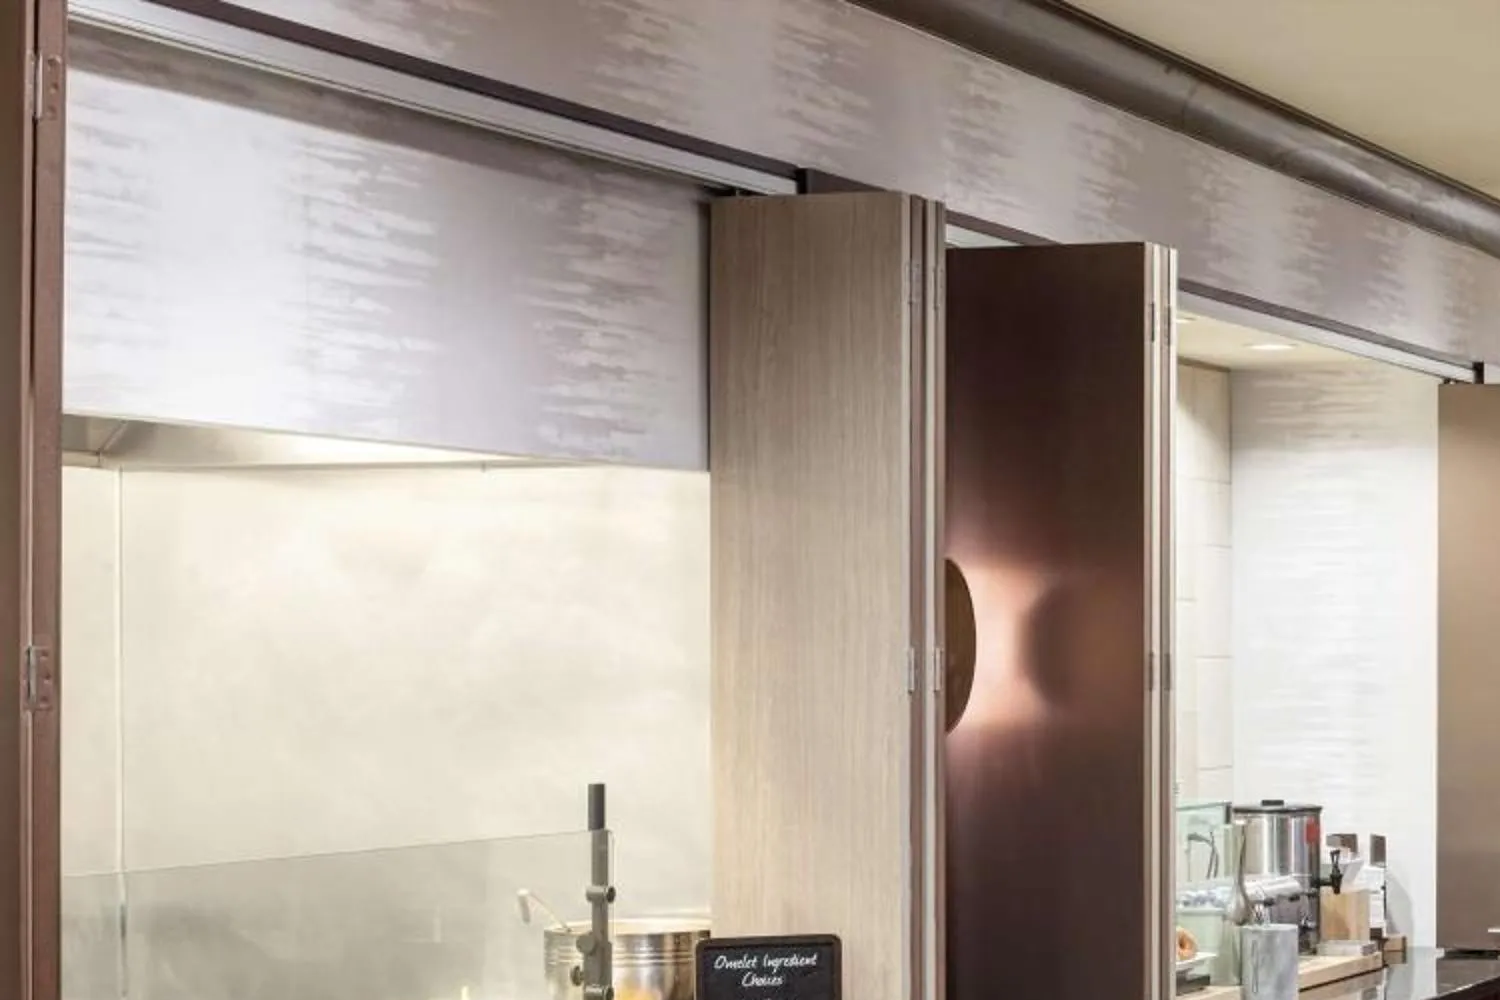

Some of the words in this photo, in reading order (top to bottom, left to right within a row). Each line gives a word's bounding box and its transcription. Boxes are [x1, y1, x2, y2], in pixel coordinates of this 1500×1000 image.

[713, 953, 757, 969] Omelet
[763, 953, 818, 975] Ingredient
[741, 971, 783, 987] Choices
